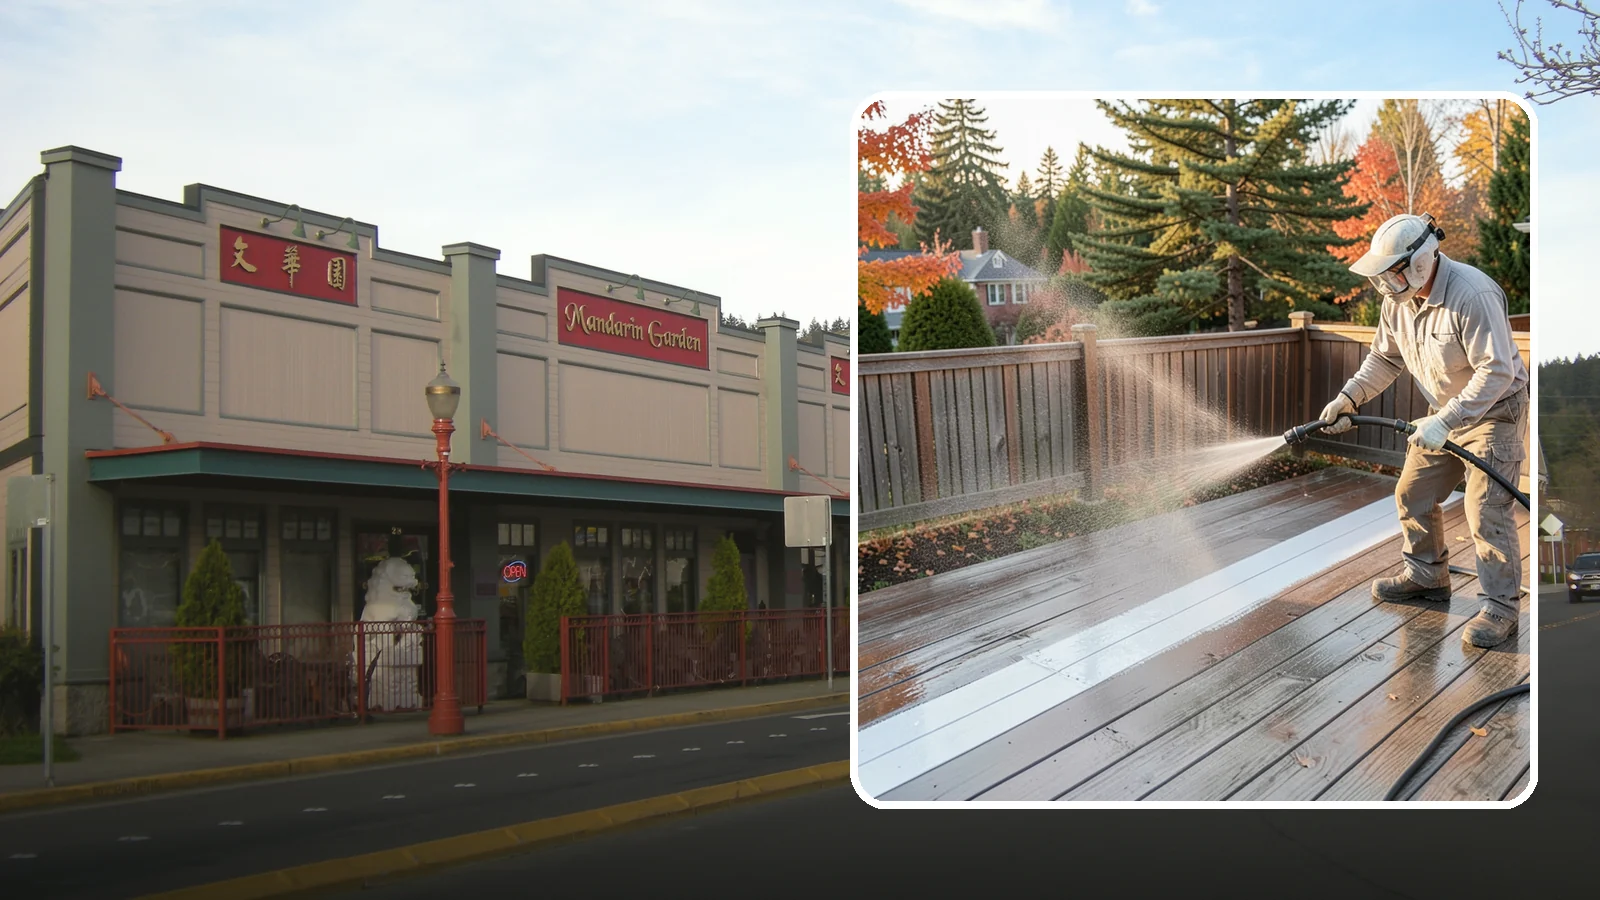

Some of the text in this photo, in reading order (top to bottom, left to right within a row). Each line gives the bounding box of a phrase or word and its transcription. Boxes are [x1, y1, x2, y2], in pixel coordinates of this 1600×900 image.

[231, 236, 347, 290] 文華園
[564, 302, 701, 352] Mandarin Garden
[503, 565, 527, 578] OPEN
